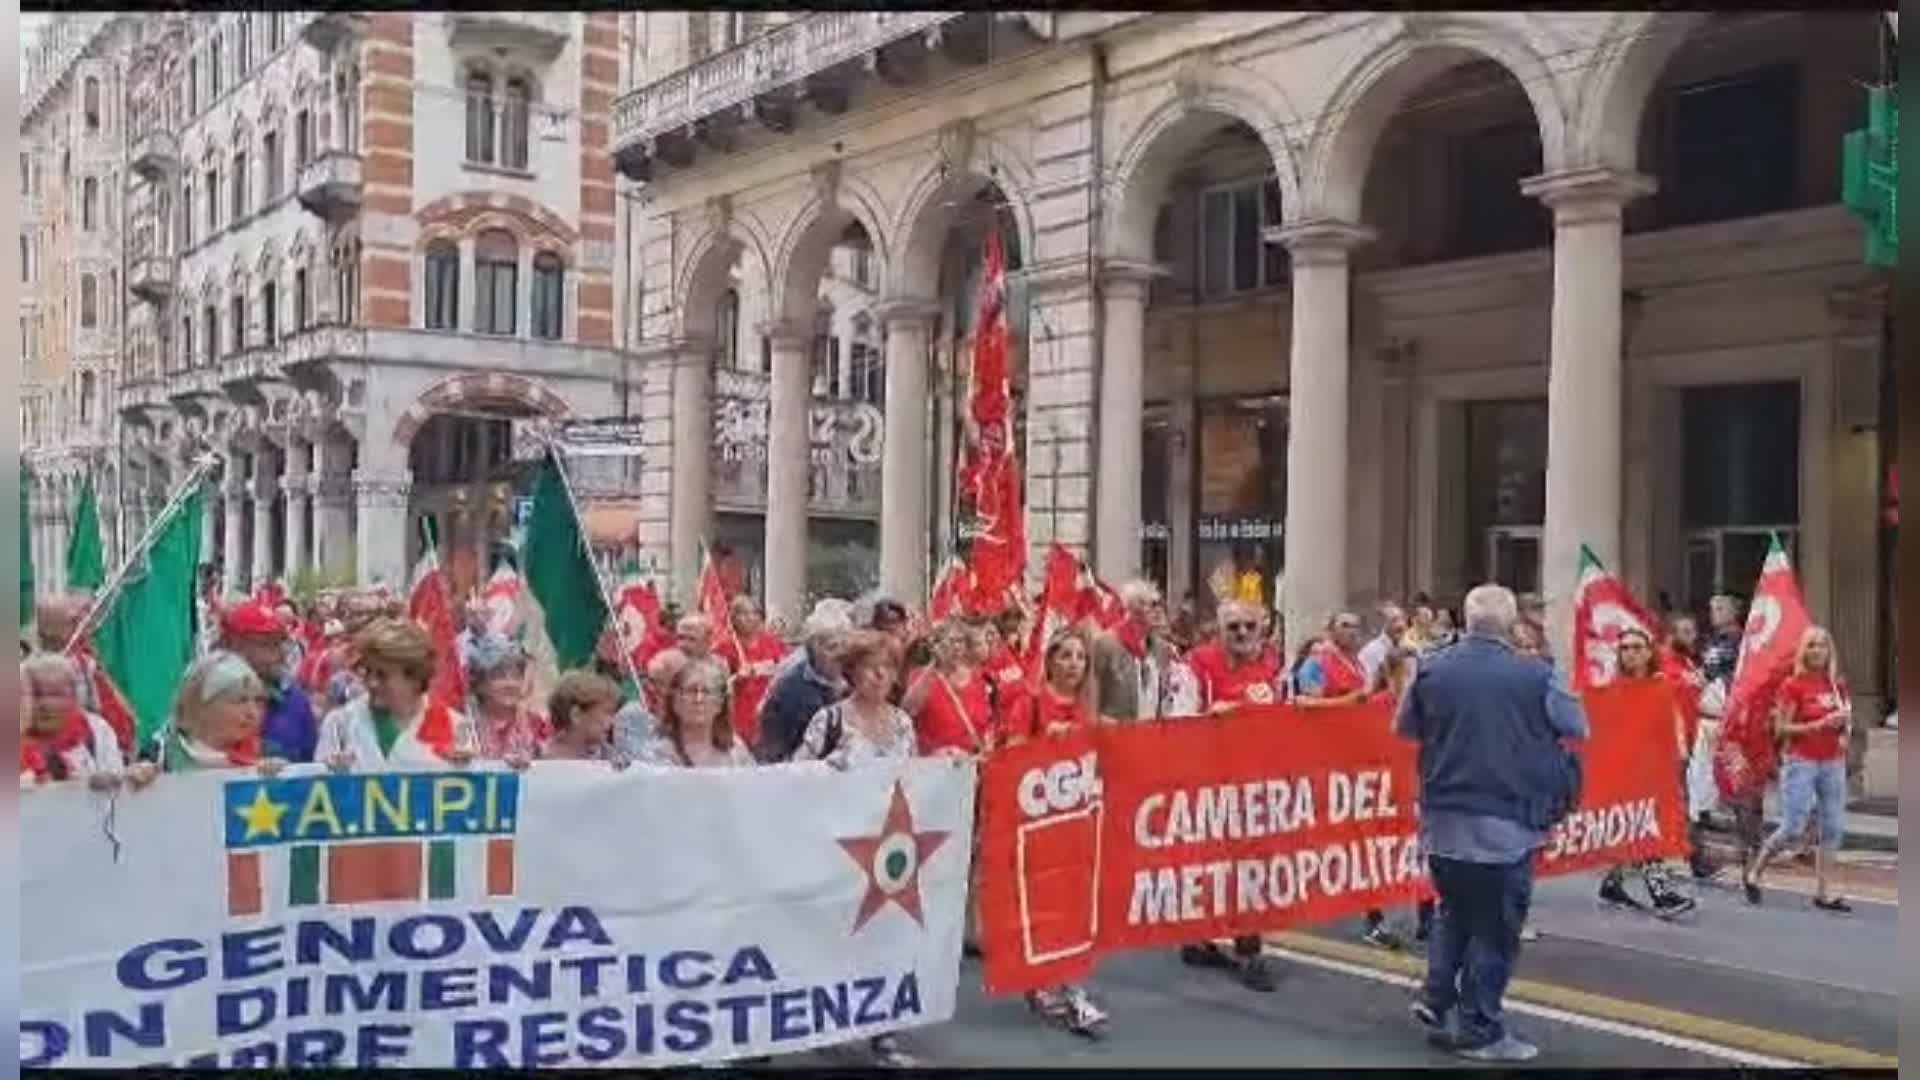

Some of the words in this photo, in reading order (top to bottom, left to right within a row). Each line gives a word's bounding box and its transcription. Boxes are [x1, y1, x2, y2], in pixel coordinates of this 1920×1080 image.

[295, 776, 512, 835] A.N.P.I.
[1134, 776, 1315, 848] CAMERA
[1328, 770, 1397, 822] DEL
[1127, 833, 1430, 925] METROPOLITA
[115, 905, 614, 991] GENOVA
[216, 945, 778, 1037] DIMENTICA
[453, 970, 923, 1069] RESISTENZA
